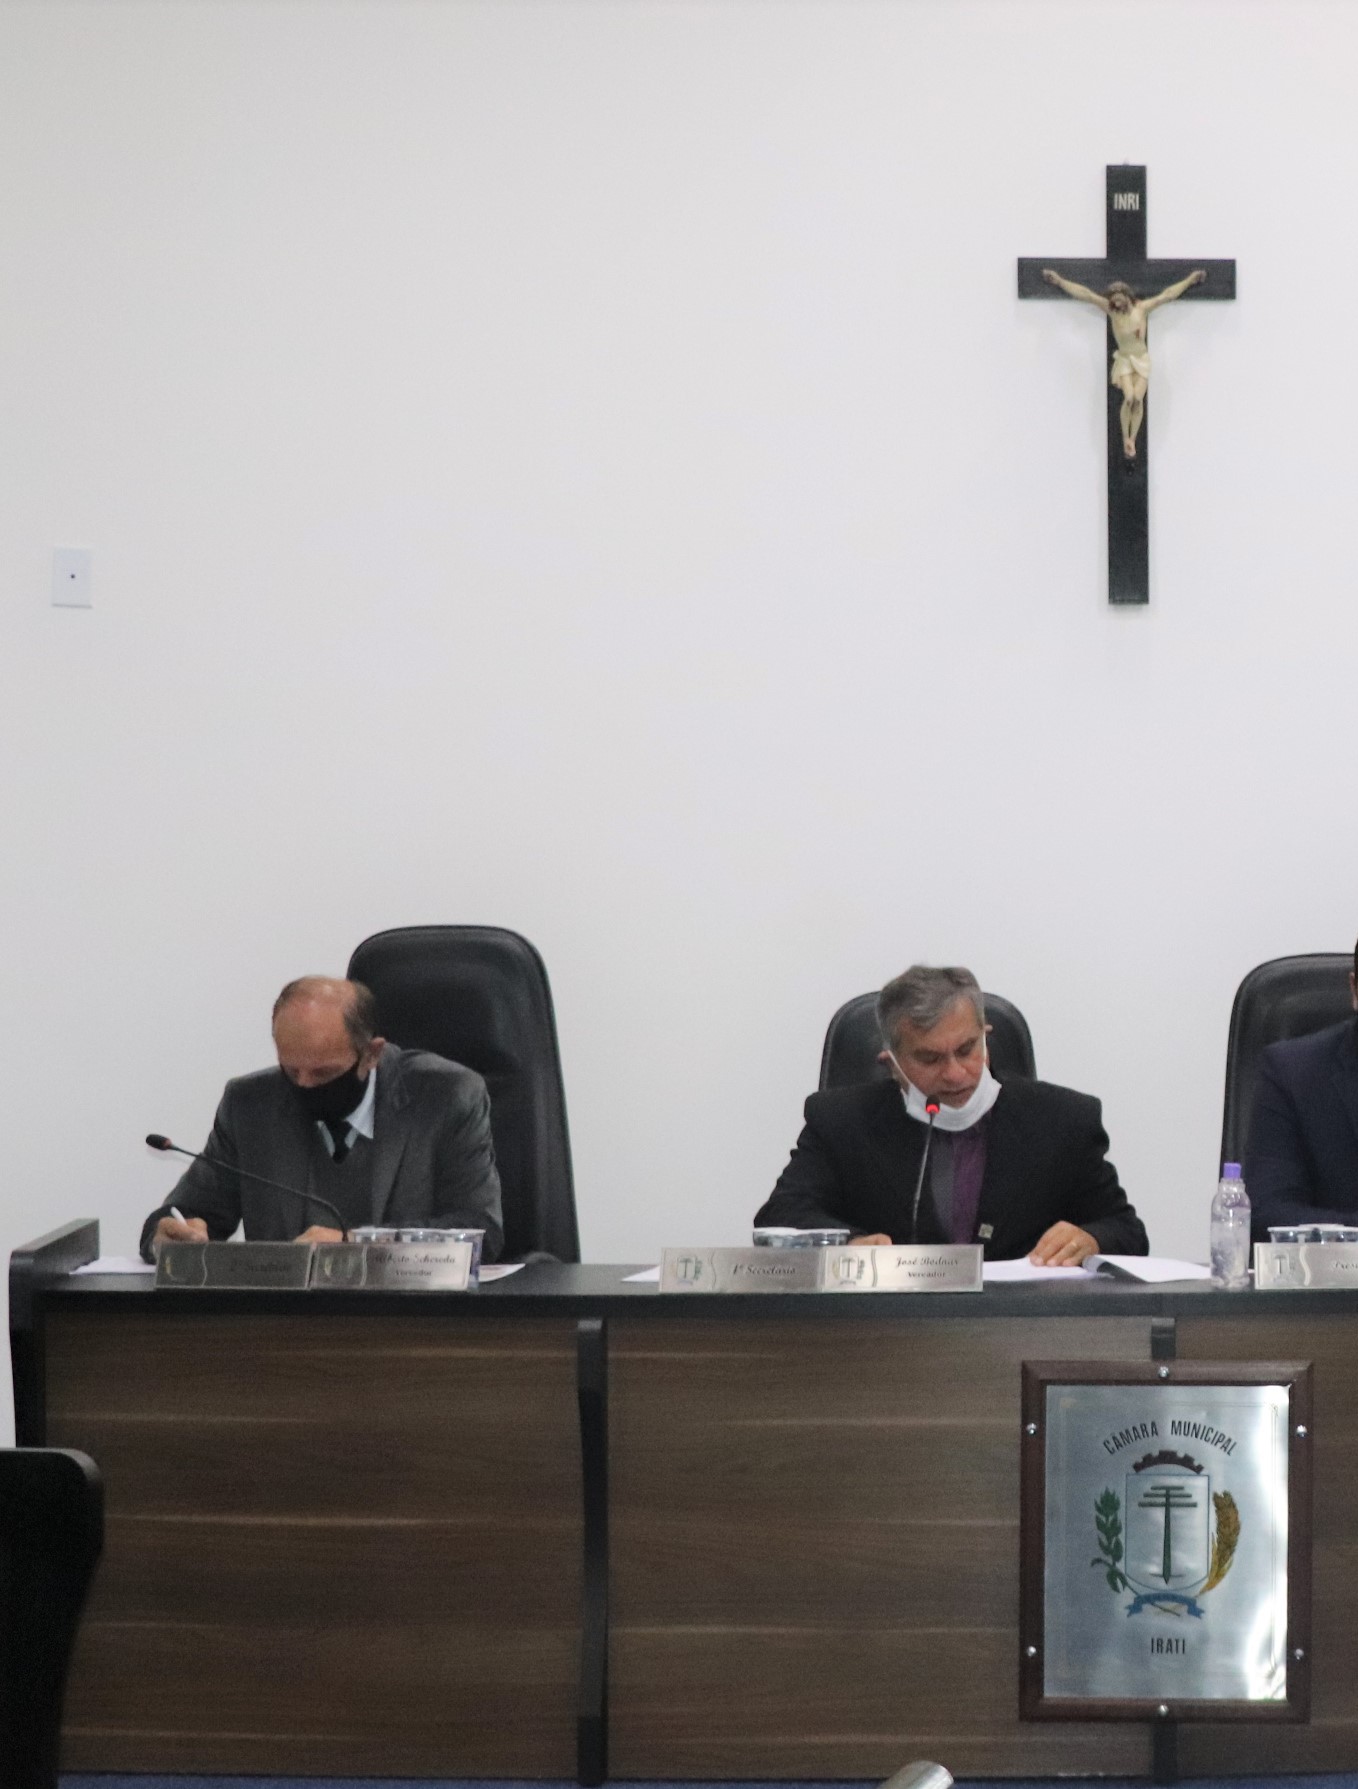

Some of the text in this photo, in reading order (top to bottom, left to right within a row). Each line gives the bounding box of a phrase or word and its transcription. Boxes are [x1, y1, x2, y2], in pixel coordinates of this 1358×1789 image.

[1113, 192, 1140, 211] INRI
[896, 1256, 918, 1268] José
[1171, 1420, 1237, 1456] MUNICIPAL
[1151, 1638, 1185, 1654] IRATI
